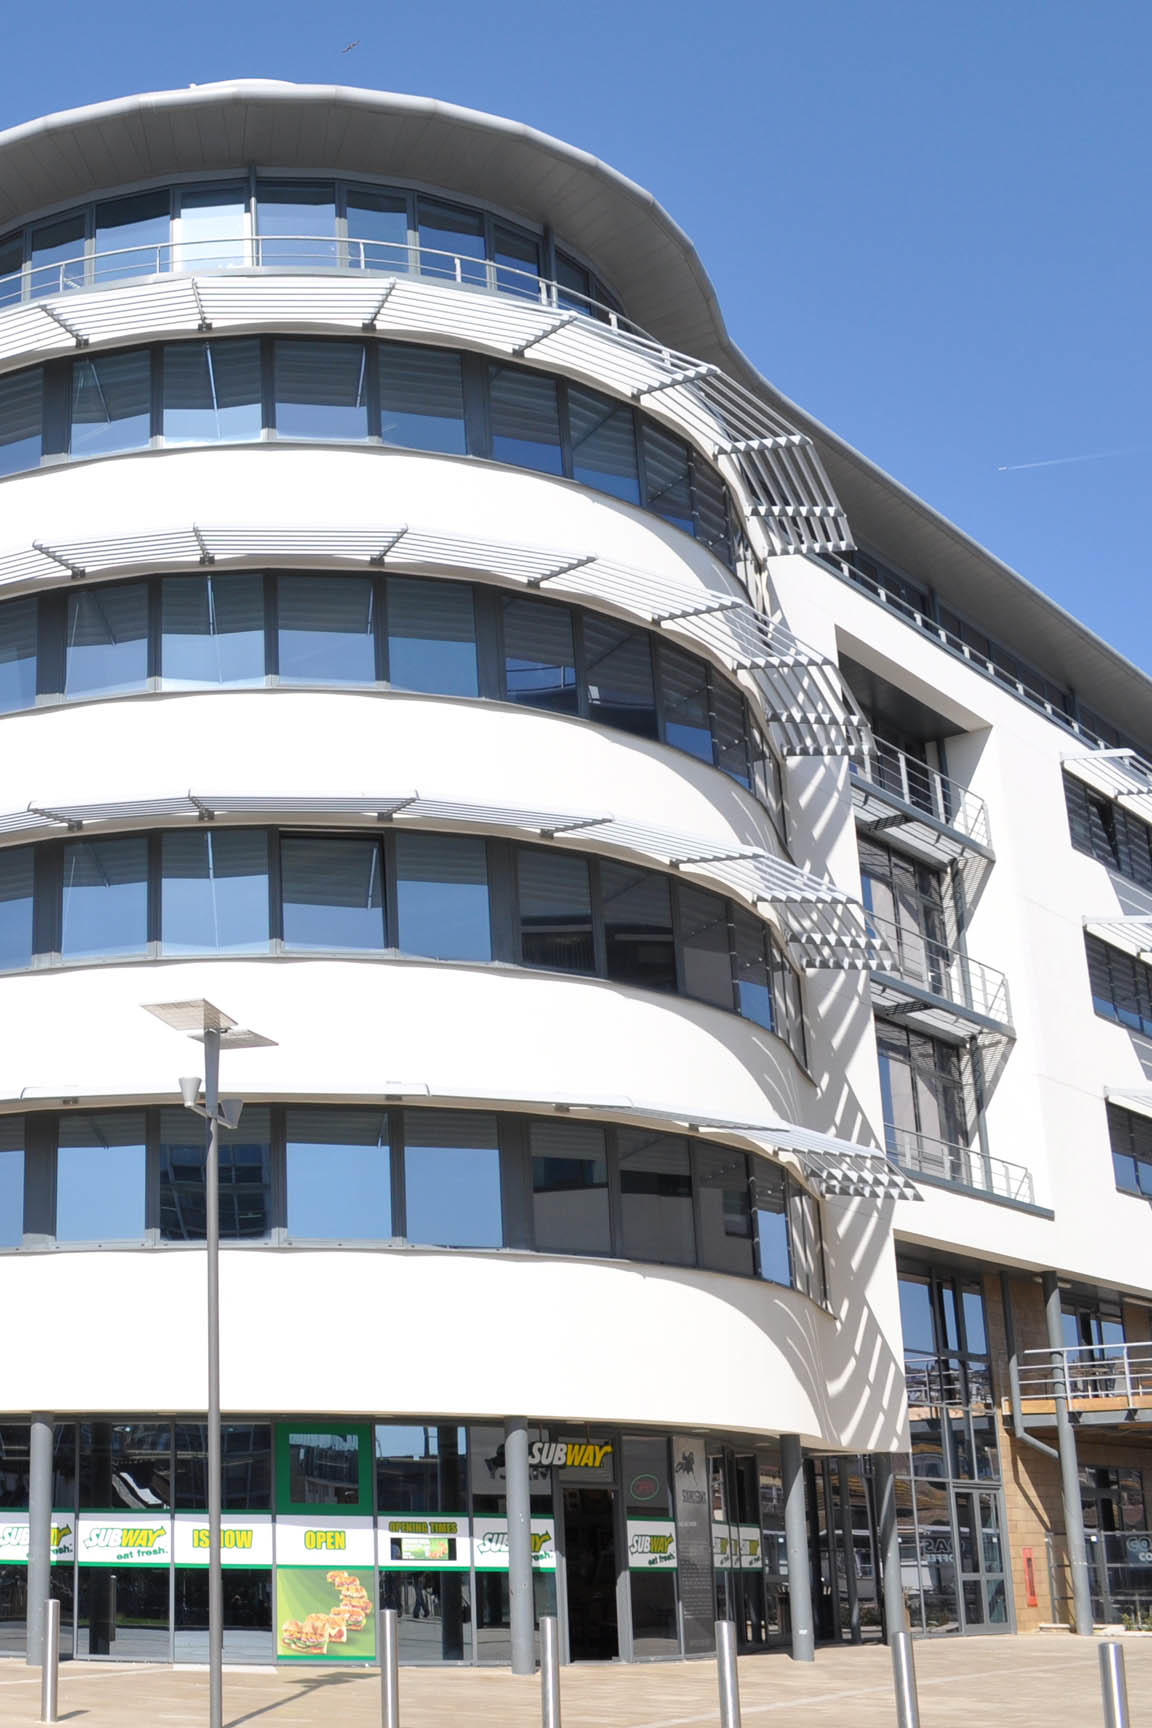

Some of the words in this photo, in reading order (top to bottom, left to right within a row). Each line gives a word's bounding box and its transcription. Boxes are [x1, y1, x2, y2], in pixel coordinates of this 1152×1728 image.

[528, 1442, 614, 1467] SUBWAY
[388, 1521, 428, 1534] OPENING
[429, 1522, 458, 1534] TIMES
[82, 1526, 166, 1549] SUBWAY
[192, 1529, 210, 1548] IS
[304, 1530, 346, 1549] OPEN
[628, 1533, 675, 1555] SUBWAY
[116, 1551, 134, 1560] eat
